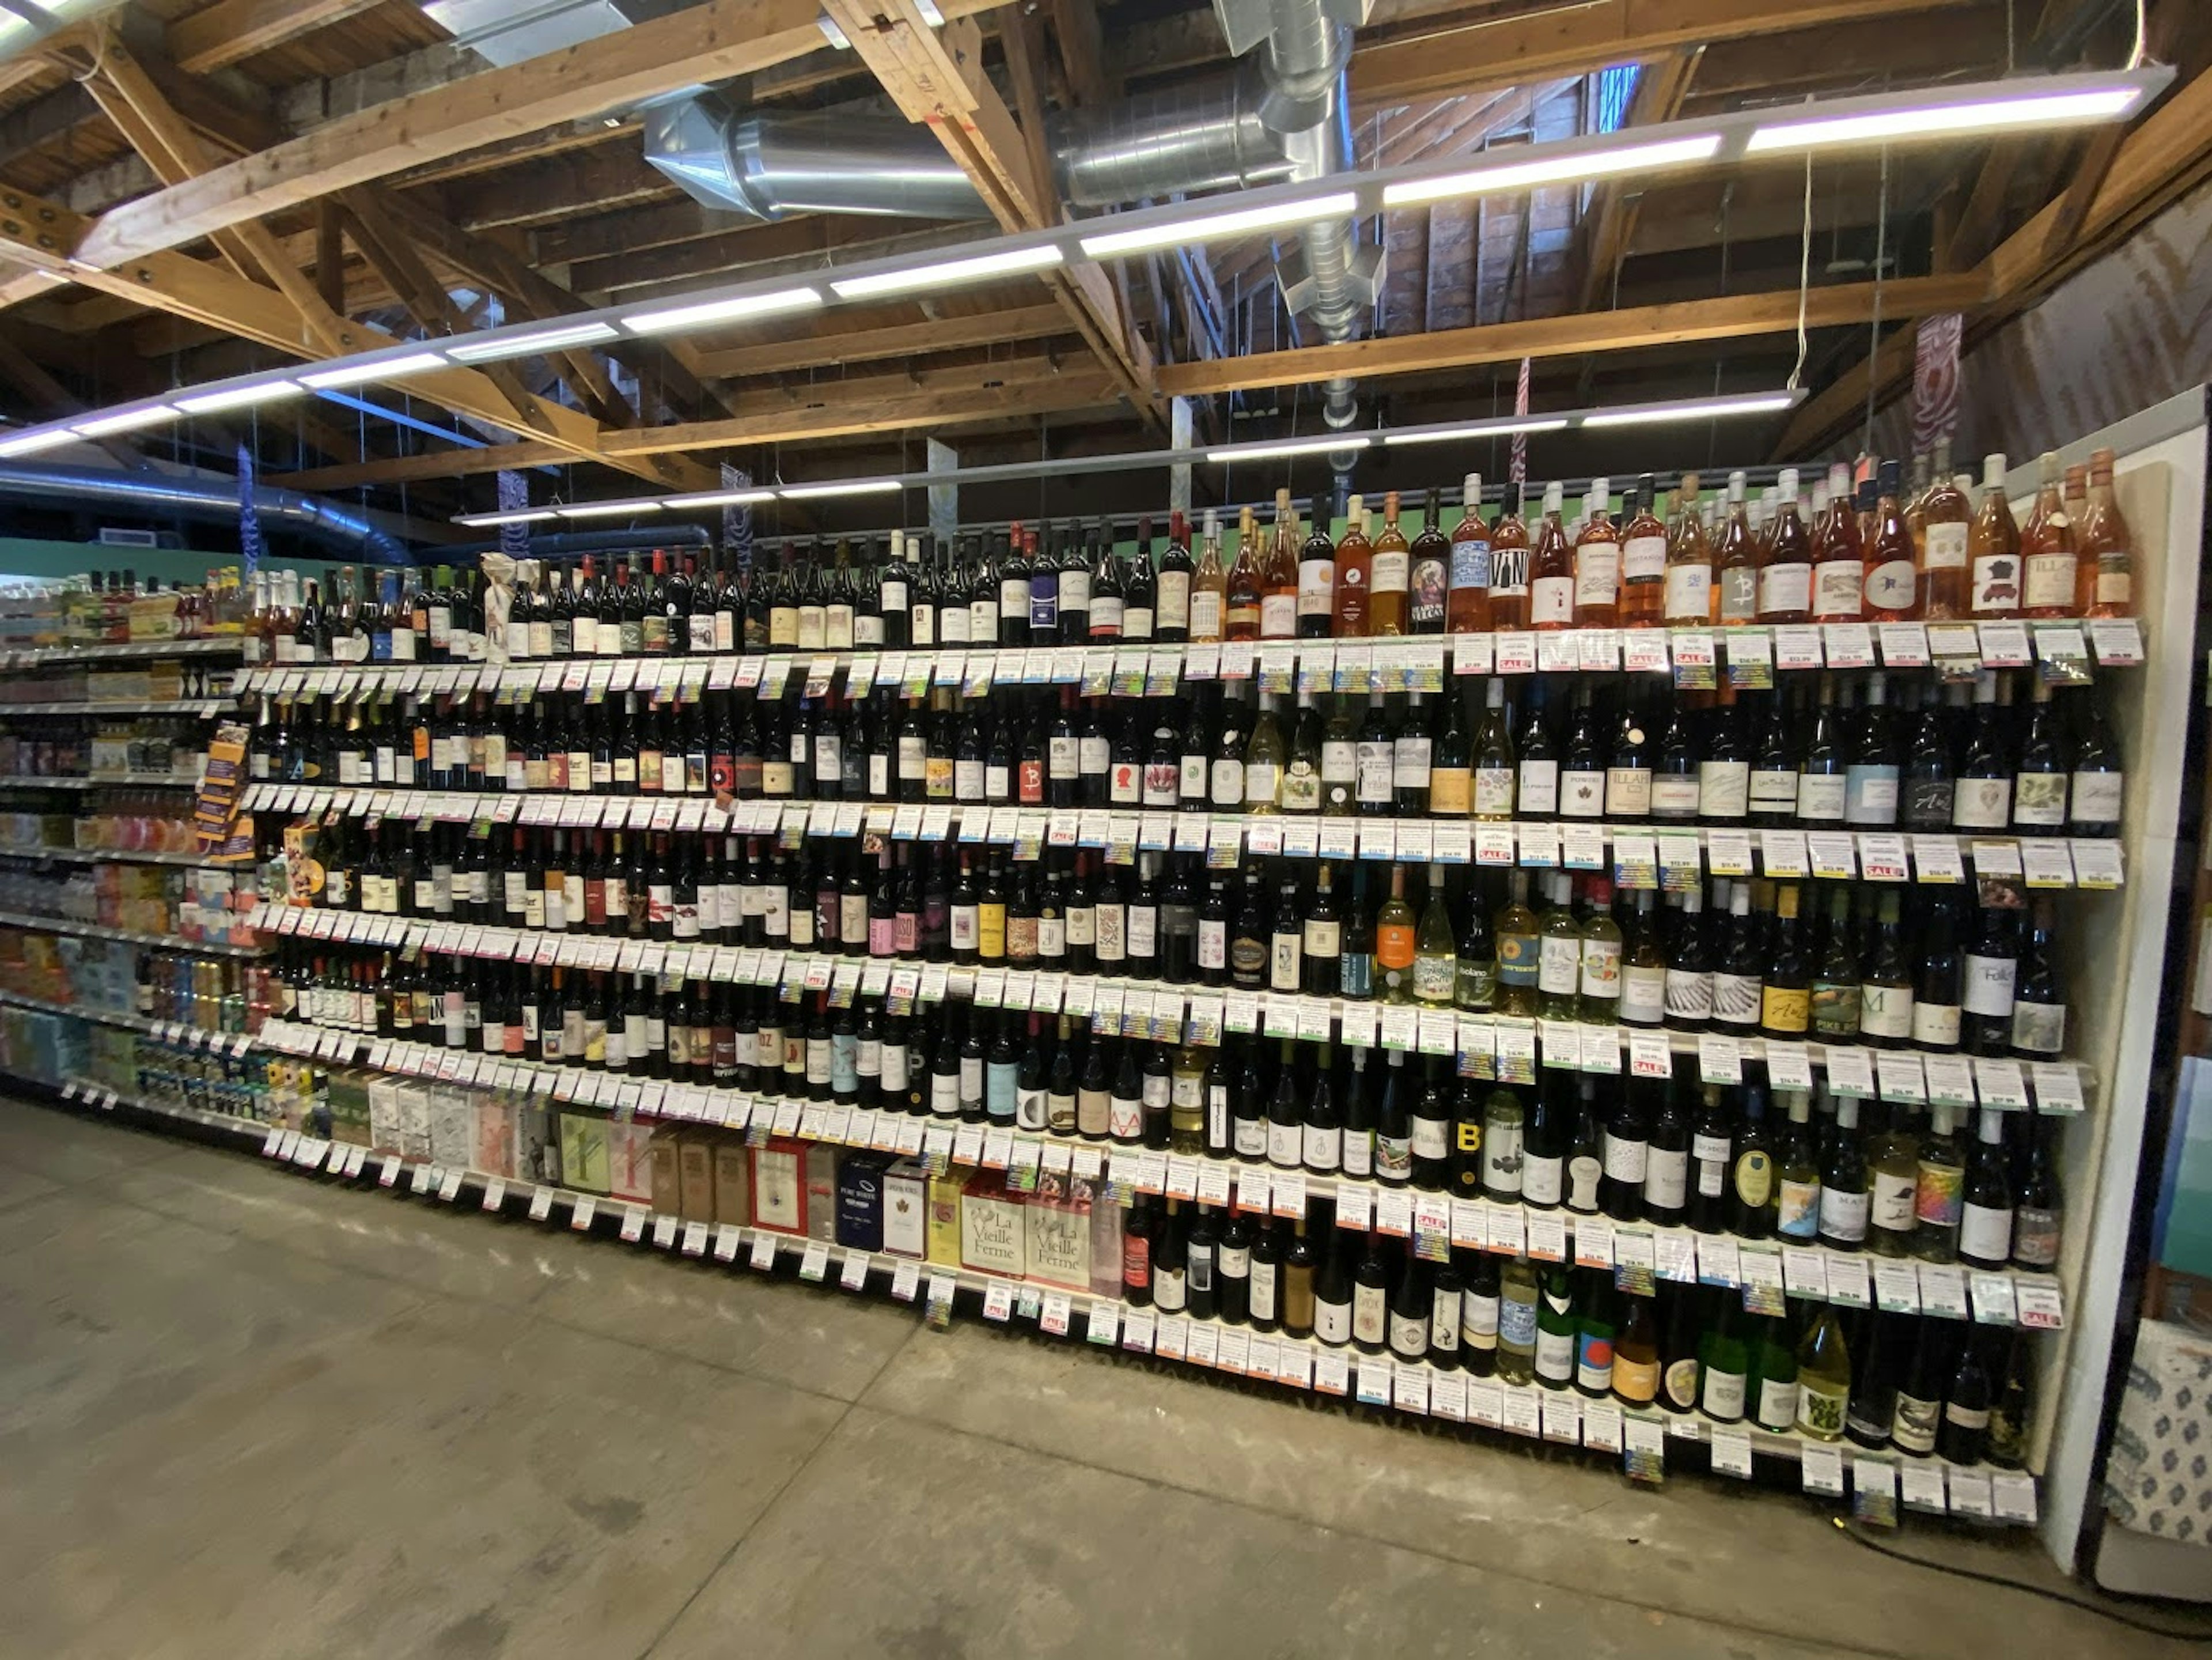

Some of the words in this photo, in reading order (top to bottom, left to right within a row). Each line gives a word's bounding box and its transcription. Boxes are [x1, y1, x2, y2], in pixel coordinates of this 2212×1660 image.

[1500, 660, 1524, 668] SALE
[1630, 655, 1655, 664] SALE
[1677, 655, 1703, 663] SALE
[1479, 850, 1503, 859] SALE
[1866, 866, 1893, 876] SALE
[1634, 1062, 1660, 1073] SALE
[1457, 1123, 1480, 1151] B
[995, 1213, 1012, 1229] La
[1418, 1216, 1441, 1227] SALE
[974, 1226, 1012, 1245] Vieille
[1060, 1223, 1077, 1239] La
[975, 1240, 1014, 1260] Ferme
[1036, 1235, 1078, 1256] Vieille
[1038, 1250, 1080, 1270] Ferme
